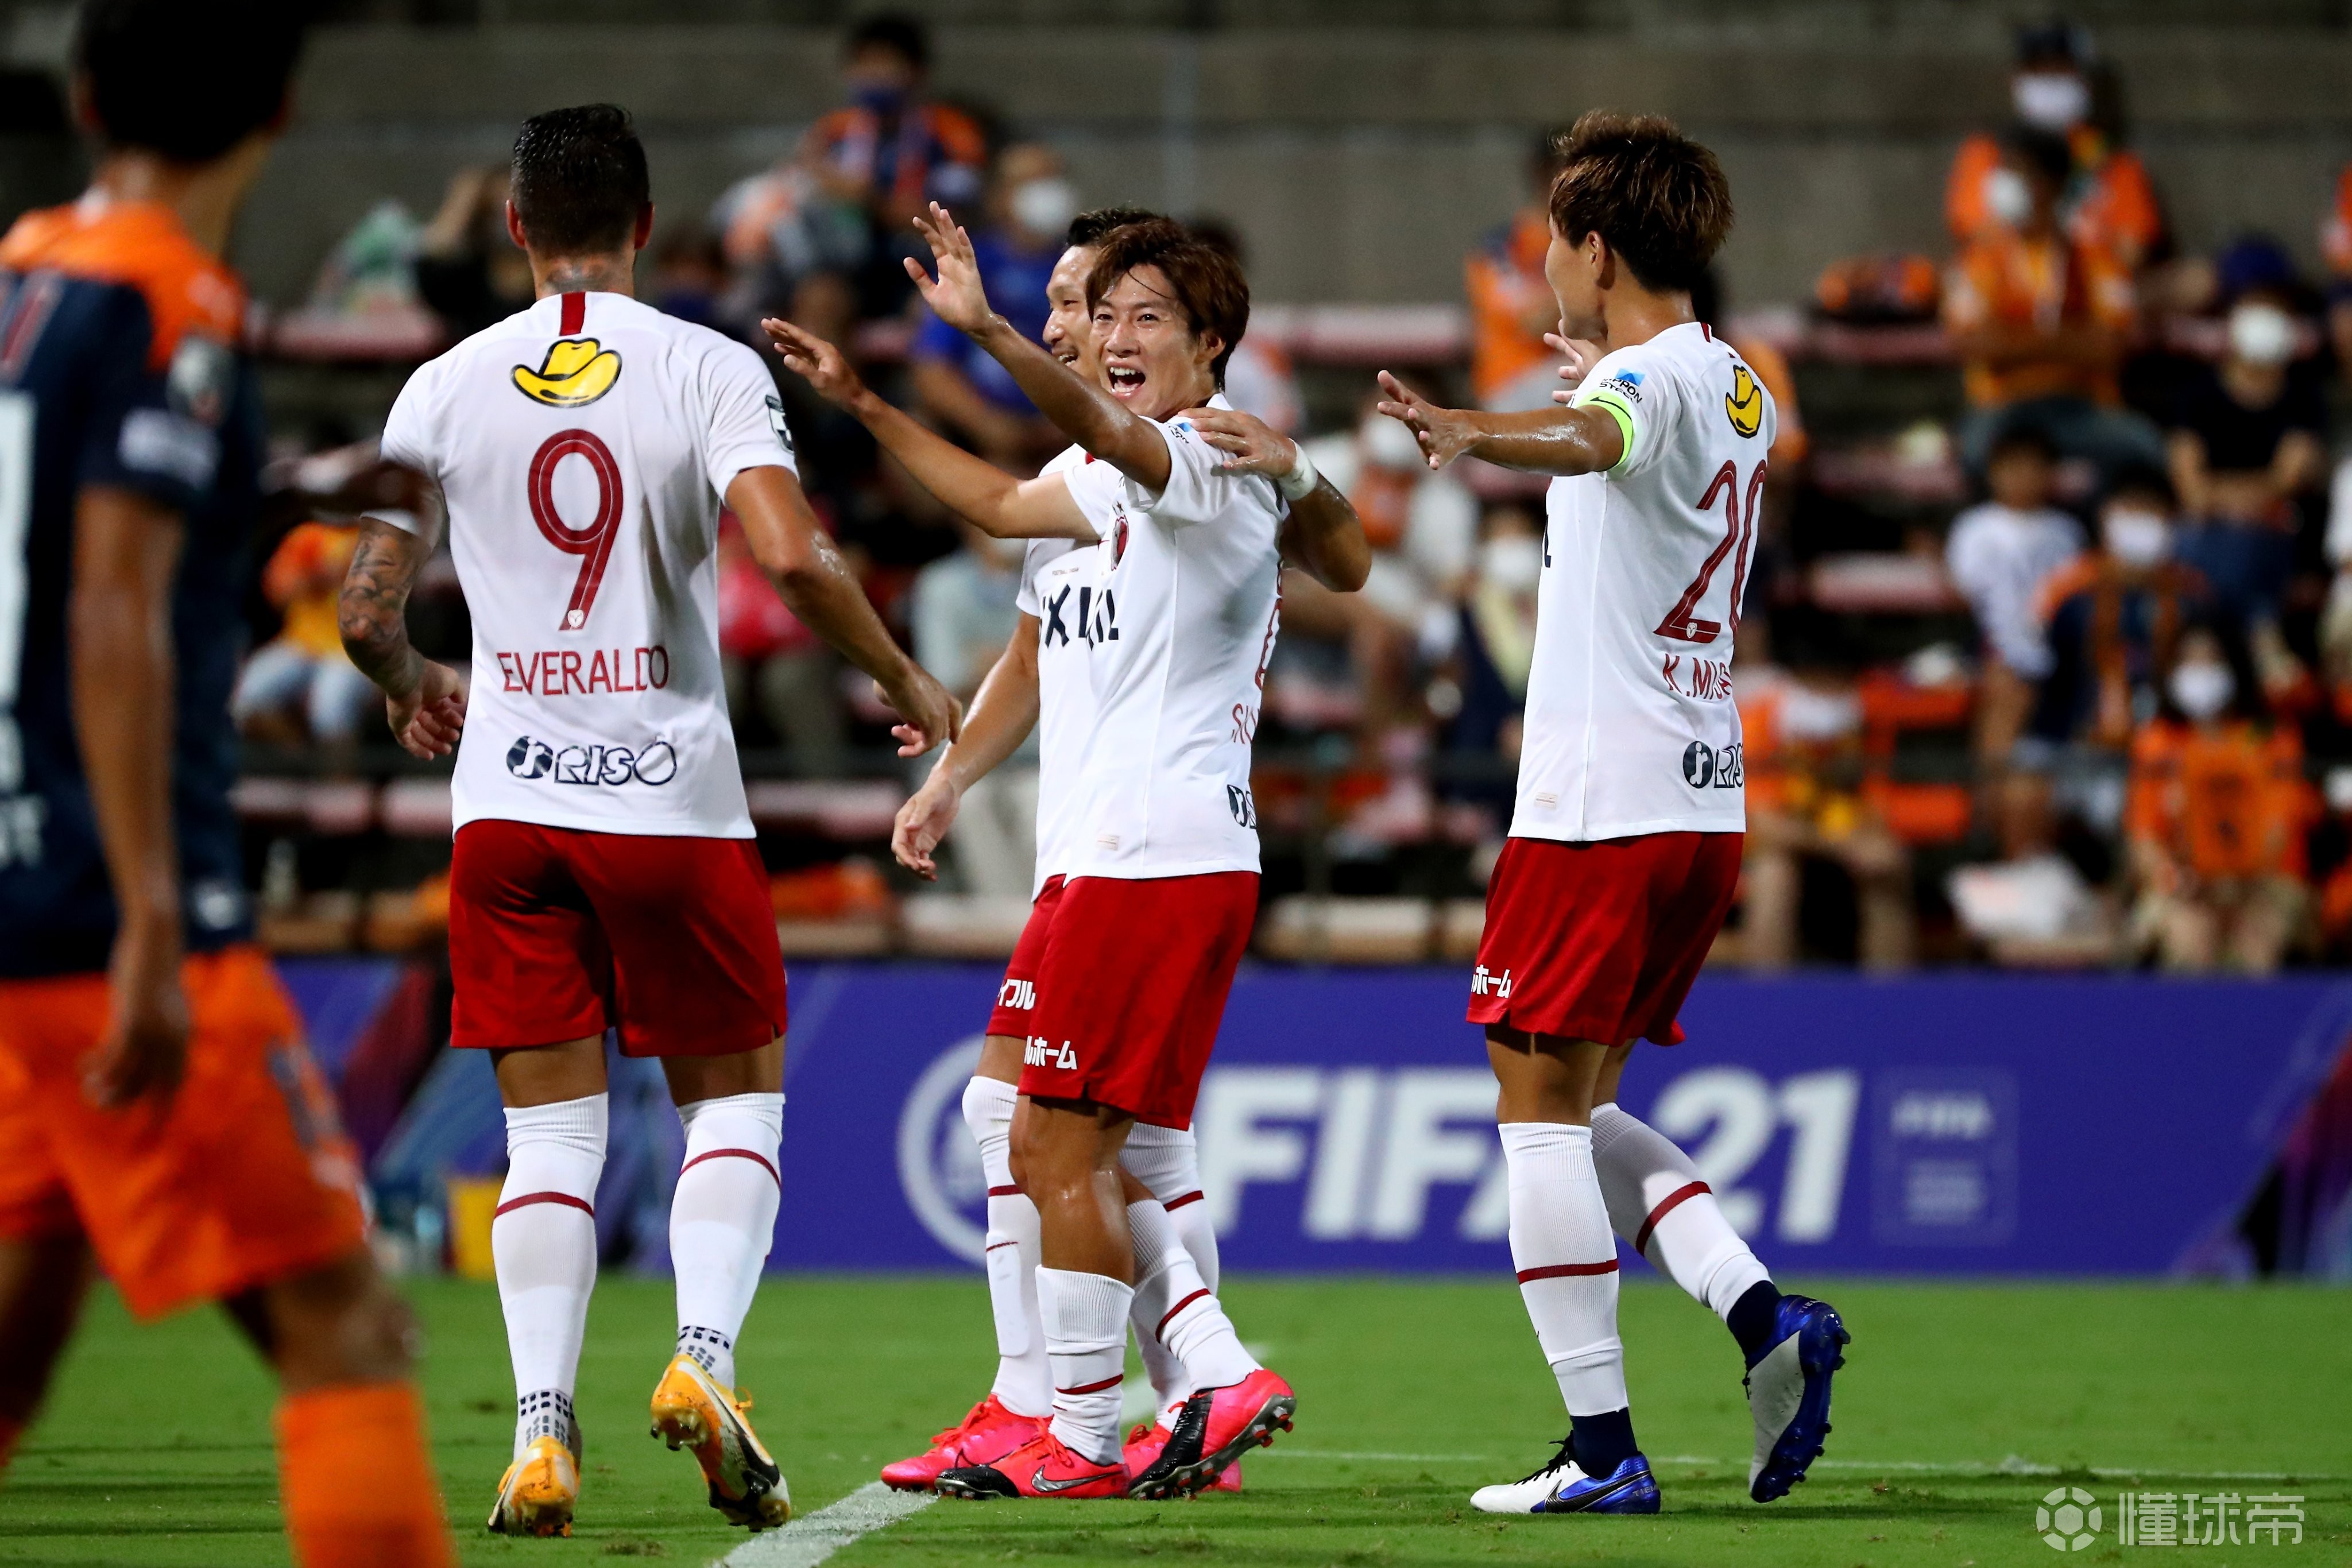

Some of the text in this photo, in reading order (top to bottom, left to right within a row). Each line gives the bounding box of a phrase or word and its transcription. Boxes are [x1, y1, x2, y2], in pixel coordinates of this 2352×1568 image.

[528, 428, 624, 631] 9
[497, 645, 669, 695] EVERALDO
[554, 741, 678, 785] RISO
[1471, 964, 1511, 998] ホーム
[1648, 1061, 1862, 1246] 21
